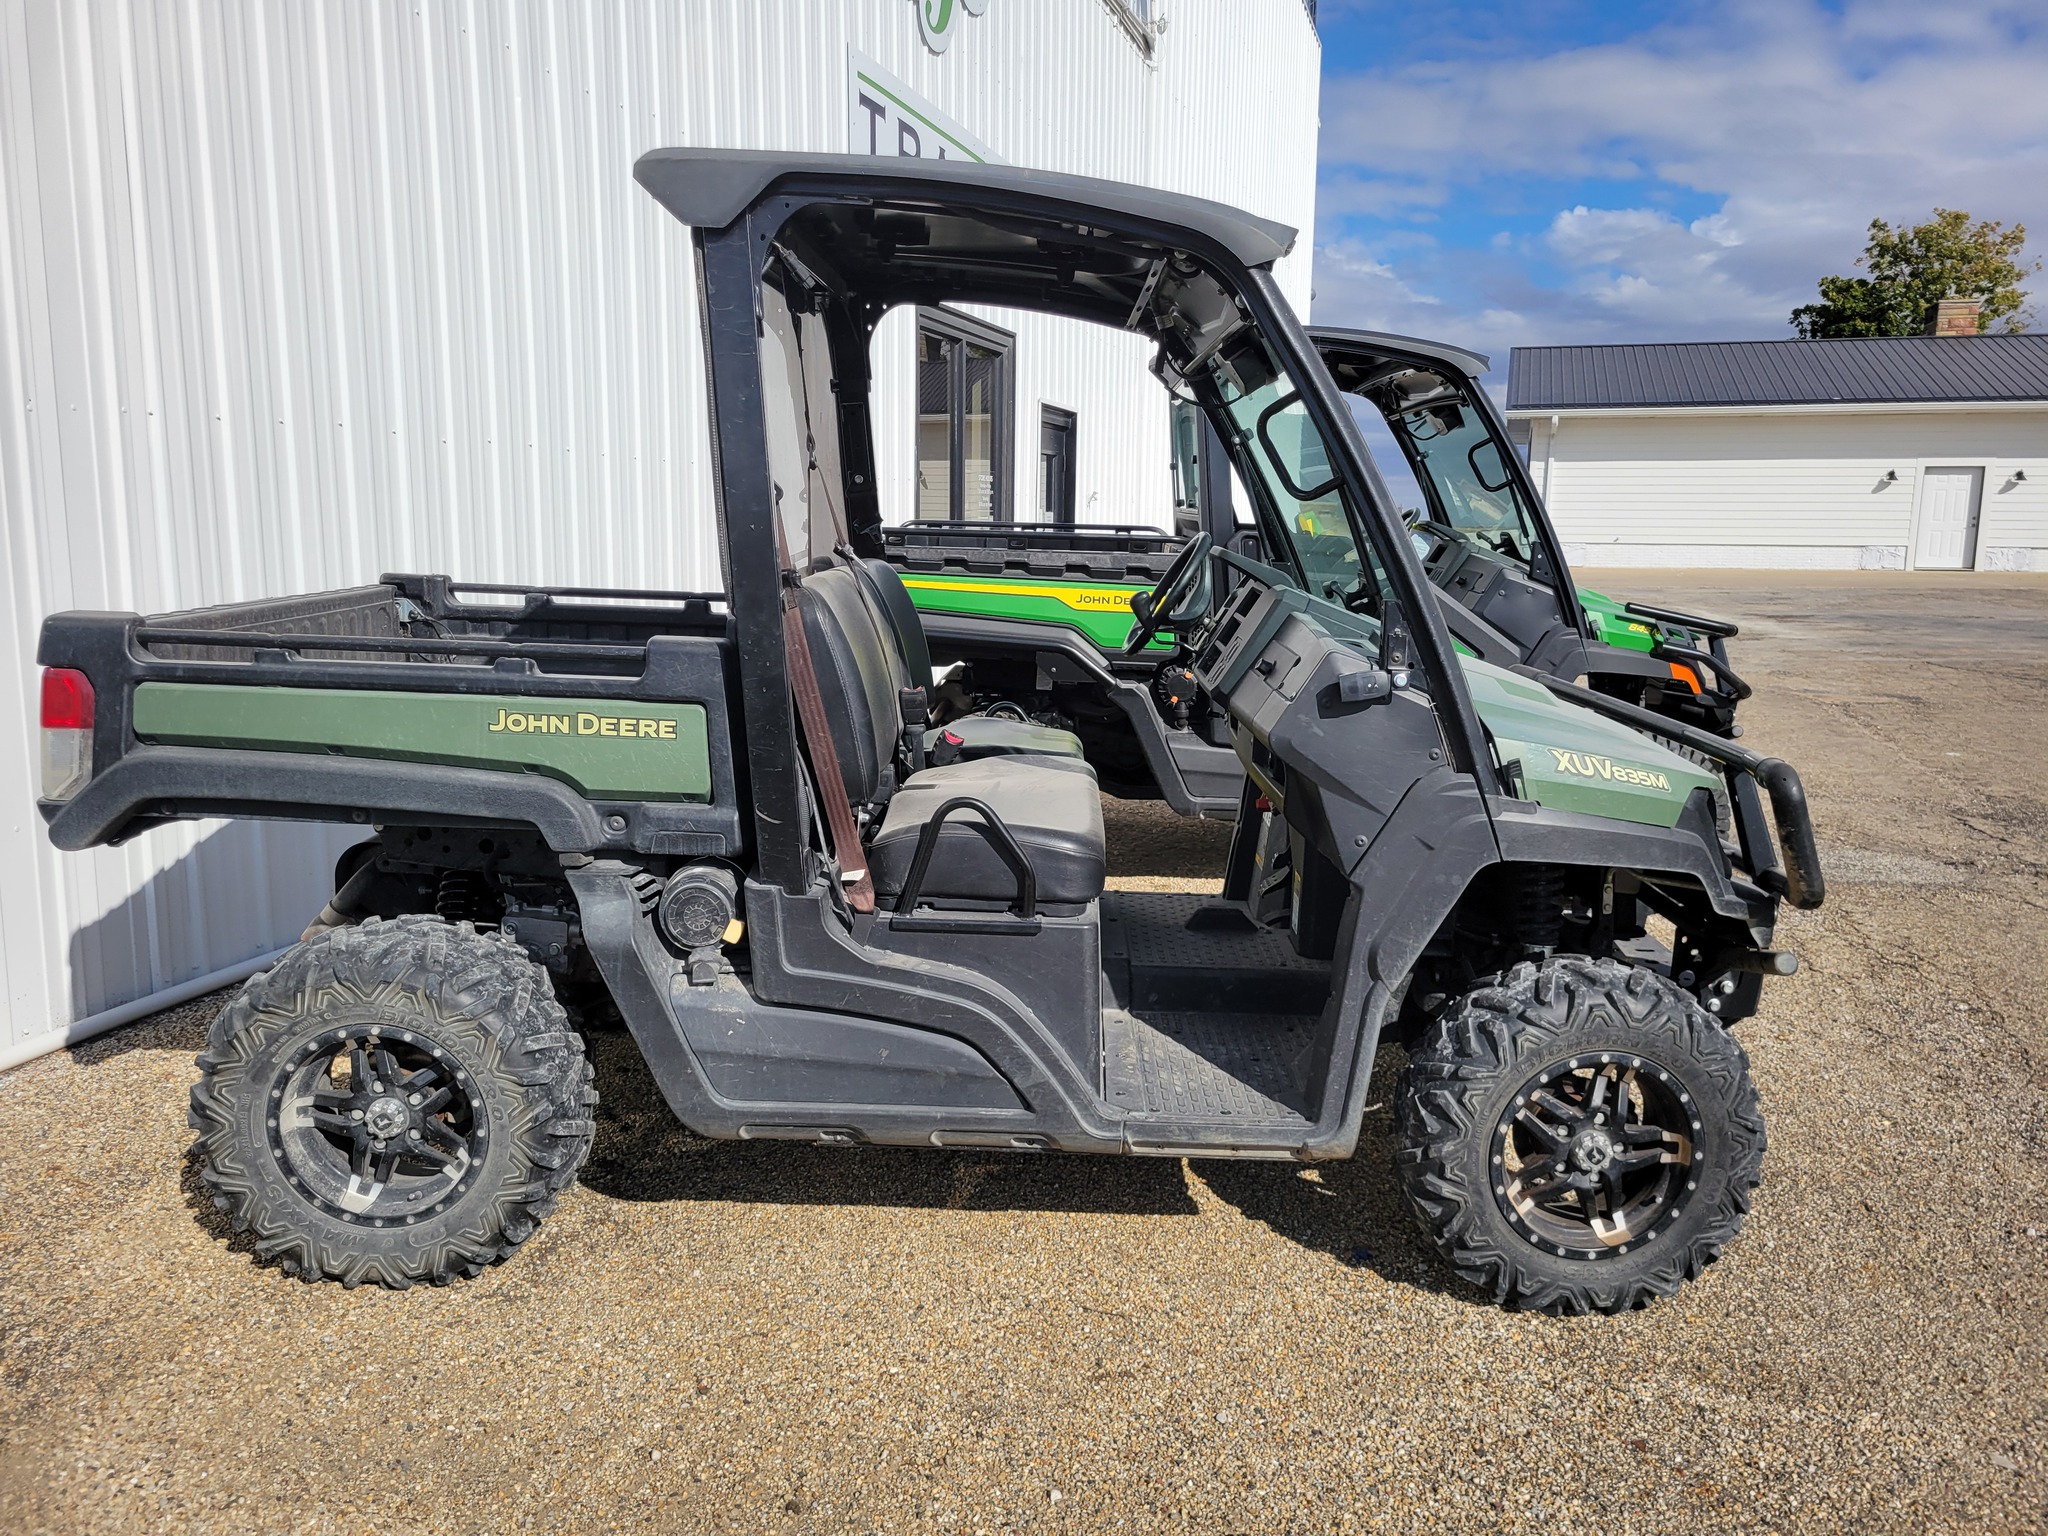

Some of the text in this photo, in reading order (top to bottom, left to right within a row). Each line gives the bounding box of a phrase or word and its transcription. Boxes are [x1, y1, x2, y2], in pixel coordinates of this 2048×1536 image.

[1076, 594, 1110, 605] JOHN
[488, 708, 678, 740] JOHN DEERE
[1550, 749, 1670, 791] XUV835M
[378, 1007, 487, 1080] BIGHORN
[265, 1184, 368, 1246] MAXXIS
